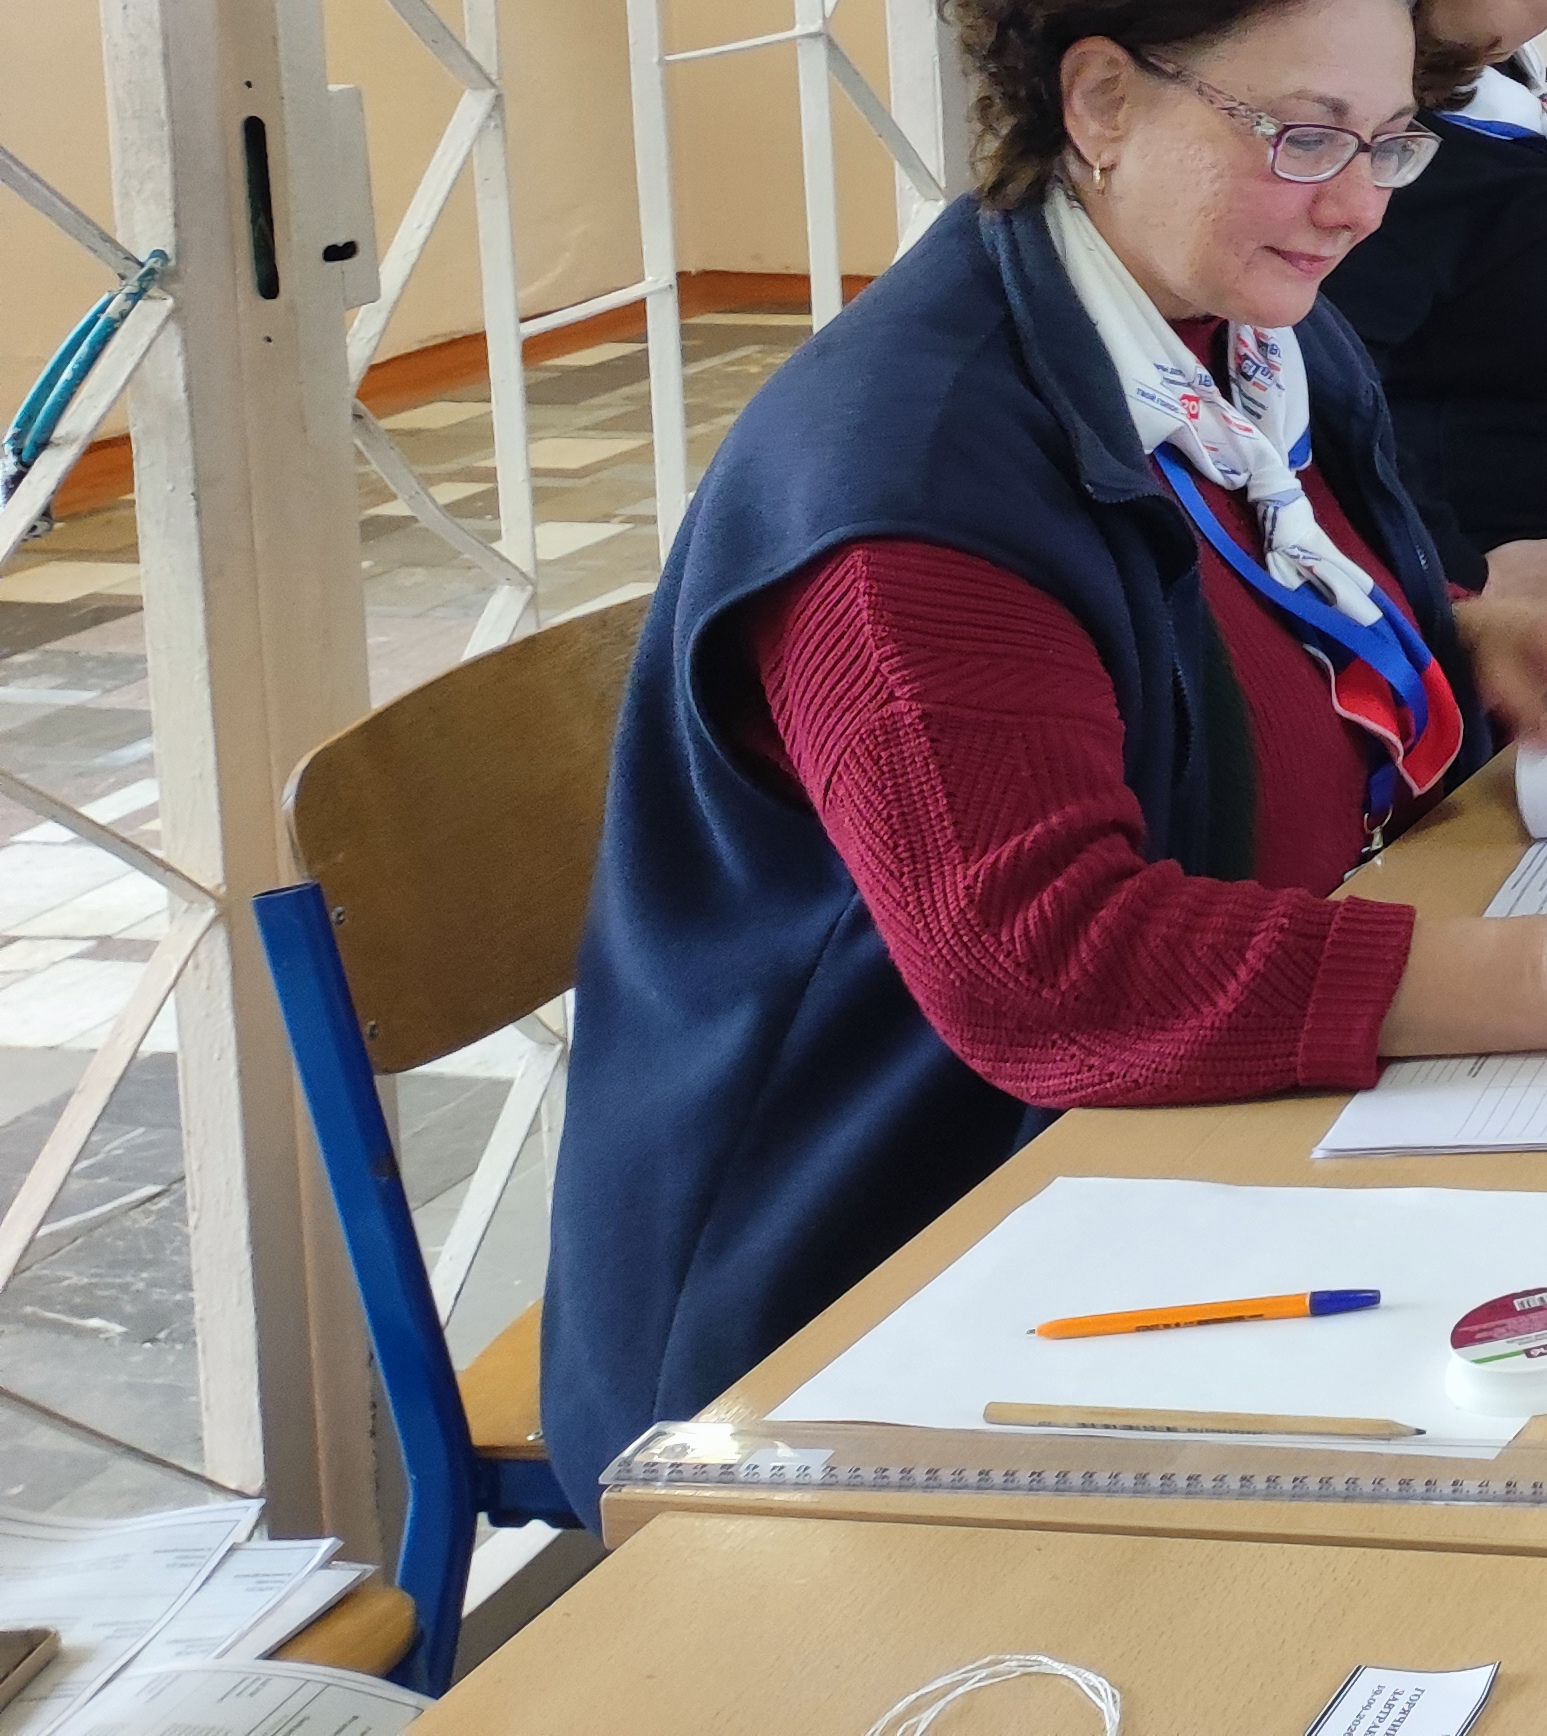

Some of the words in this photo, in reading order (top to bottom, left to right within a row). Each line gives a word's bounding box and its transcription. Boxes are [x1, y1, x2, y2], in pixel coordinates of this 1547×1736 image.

[1292, 1475, 1308, 1483] 24
[1318, 1476, 1334, 1484] 23
[1345, 1477, 1360, 1485] 22
[1371, 1477, 1386, 1485] 21
[1398, 1478, 1414, 1486] 20
[1424, 1478, 1437, 1486] 19
[1451, 1479, 1464, 1487] 18
[1478, 1480, 1490, 1488] 17
[1505, 1480, 1517, 1488] 16
[1531, 1481, 1543, 1489] 15
